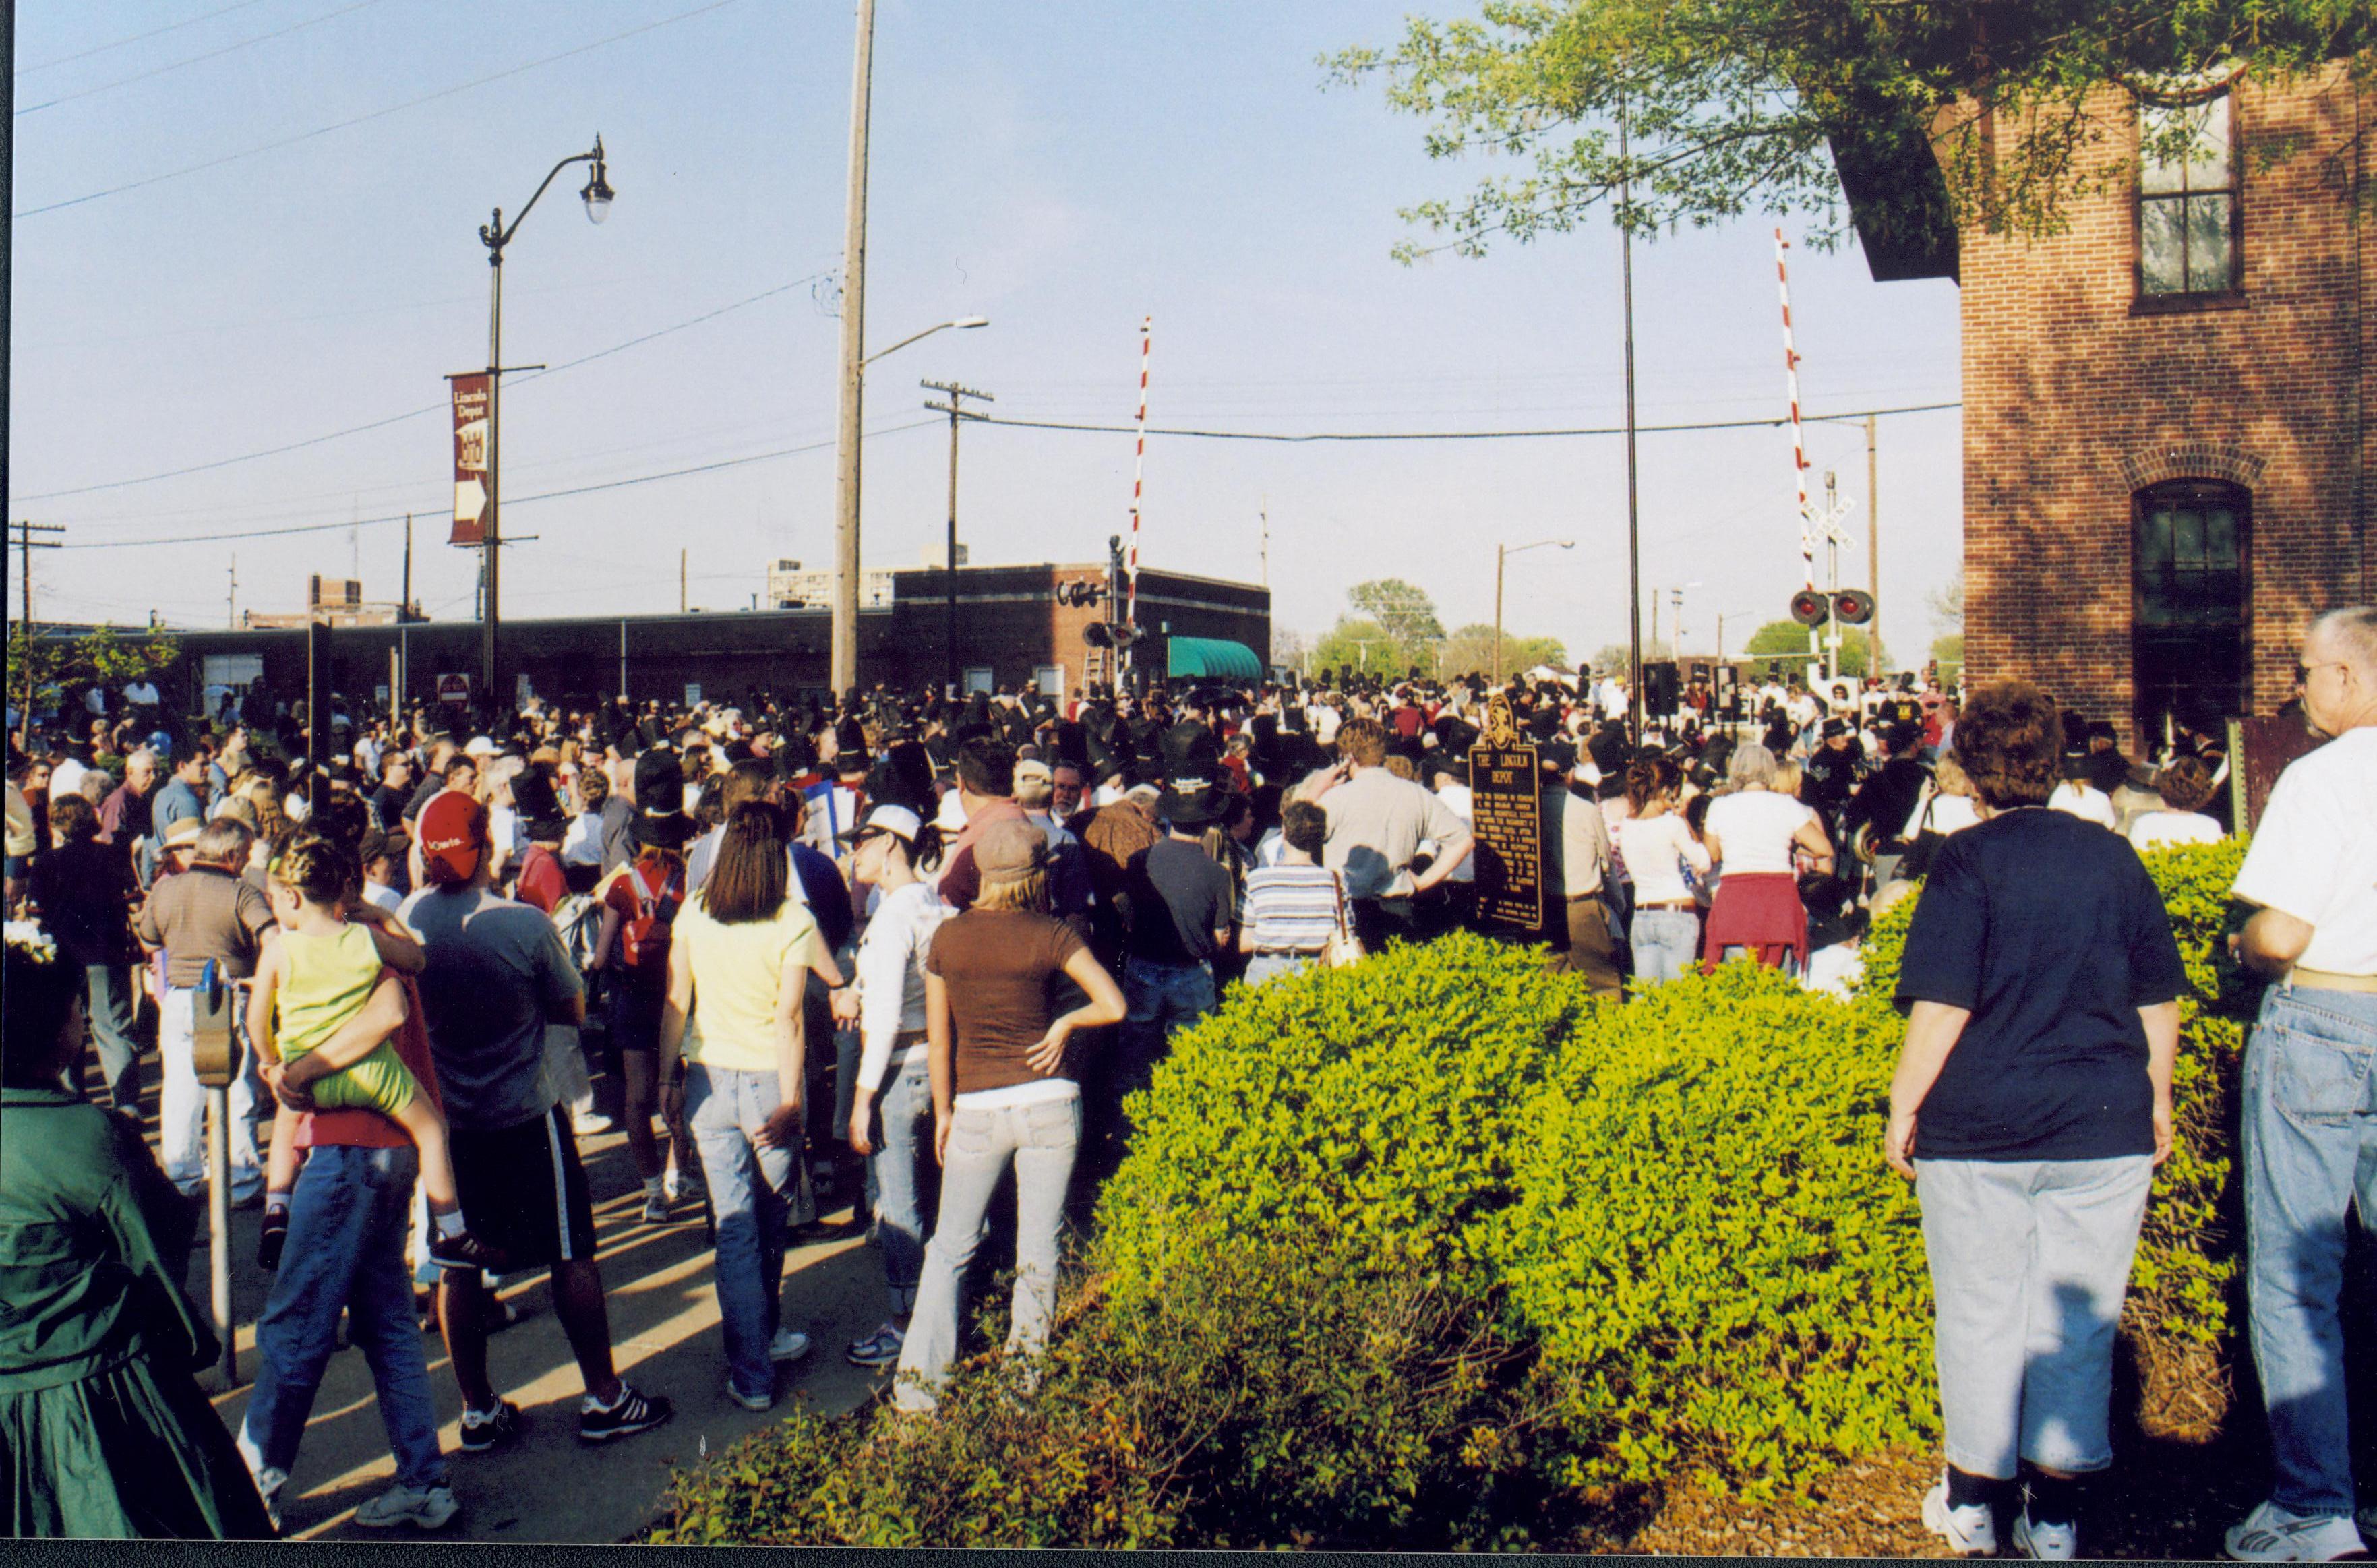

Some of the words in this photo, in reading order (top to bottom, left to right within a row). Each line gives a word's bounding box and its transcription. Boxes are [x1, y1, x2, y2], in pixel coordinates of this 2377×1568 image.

[454, 388, 487, 404] Lincoln
[458, 405, 484, 421] Depot
[1805, 500, 1853, 550] CROSSING
[1477, 754, 1491, 767] THE
[1500, 754, 1528, 768] LINCOLN
[1492, 771, 1513, 784] DEPOT
